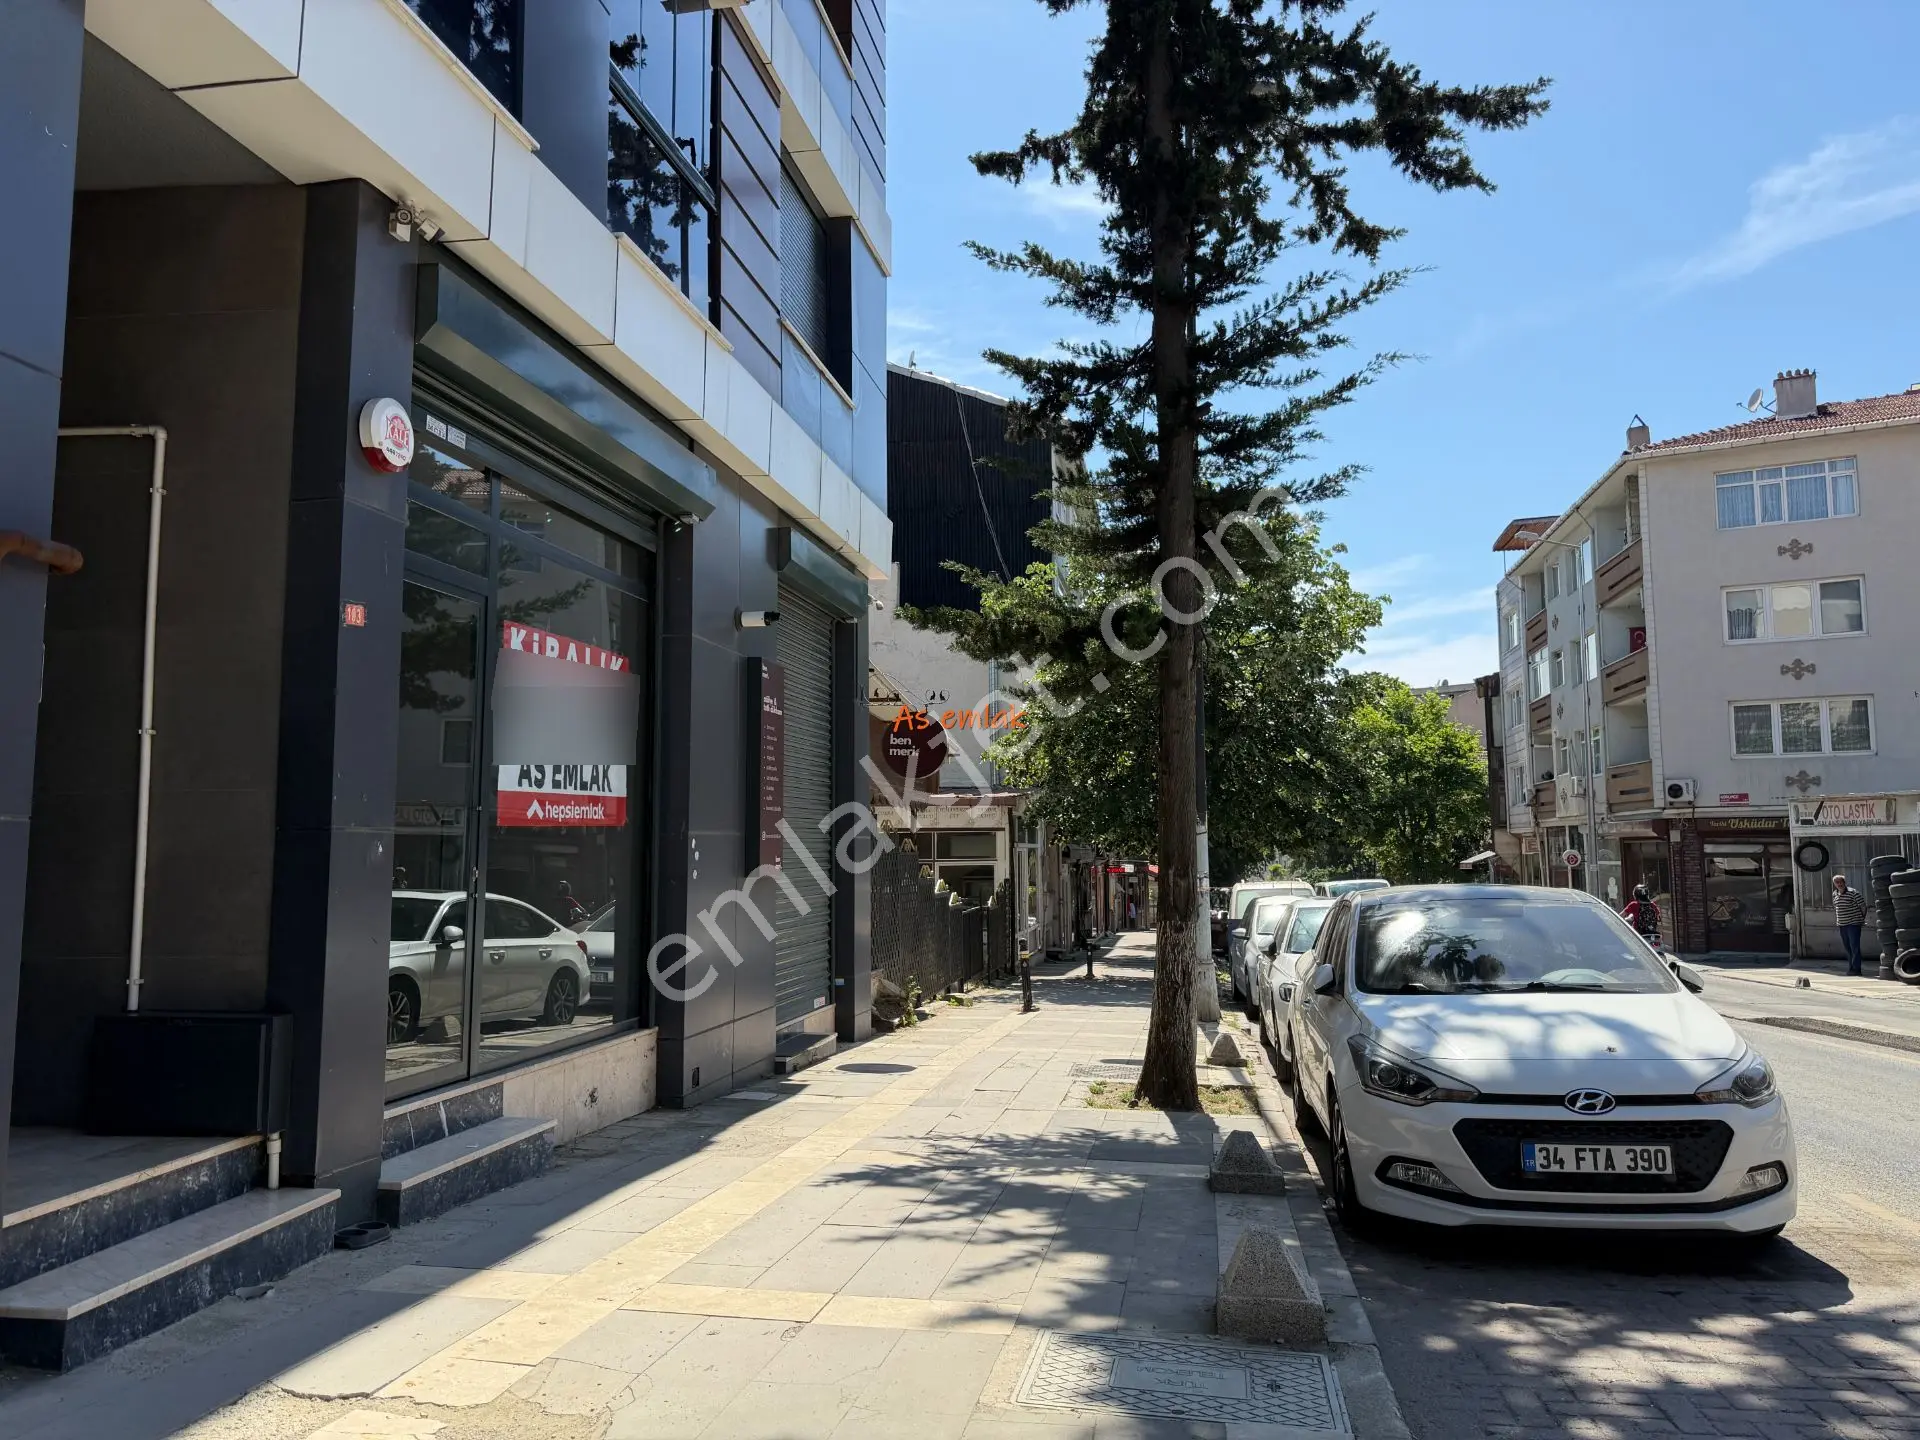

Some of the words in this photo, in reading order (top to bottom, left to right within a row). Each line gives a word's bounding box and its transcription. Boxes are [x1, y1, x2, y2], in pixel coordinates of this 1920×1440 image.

[889, 733, 912, 745] ben
[517, 765, 546, 790] AS
[551, 765, 613, 793] EMLAK
[545, 800, 605, 822] hepsiemlak
[1822, 804, 1841, 820] OTO
[1843, 800, 1876, 819] LASTİK
[1525, 1159, 1535, 1168] TR
[1538, 1146, 1565, 1170] 34
[1574, 1147, 1616, 1171] FTA
[1625, 1148, 1667, 1172] 390
